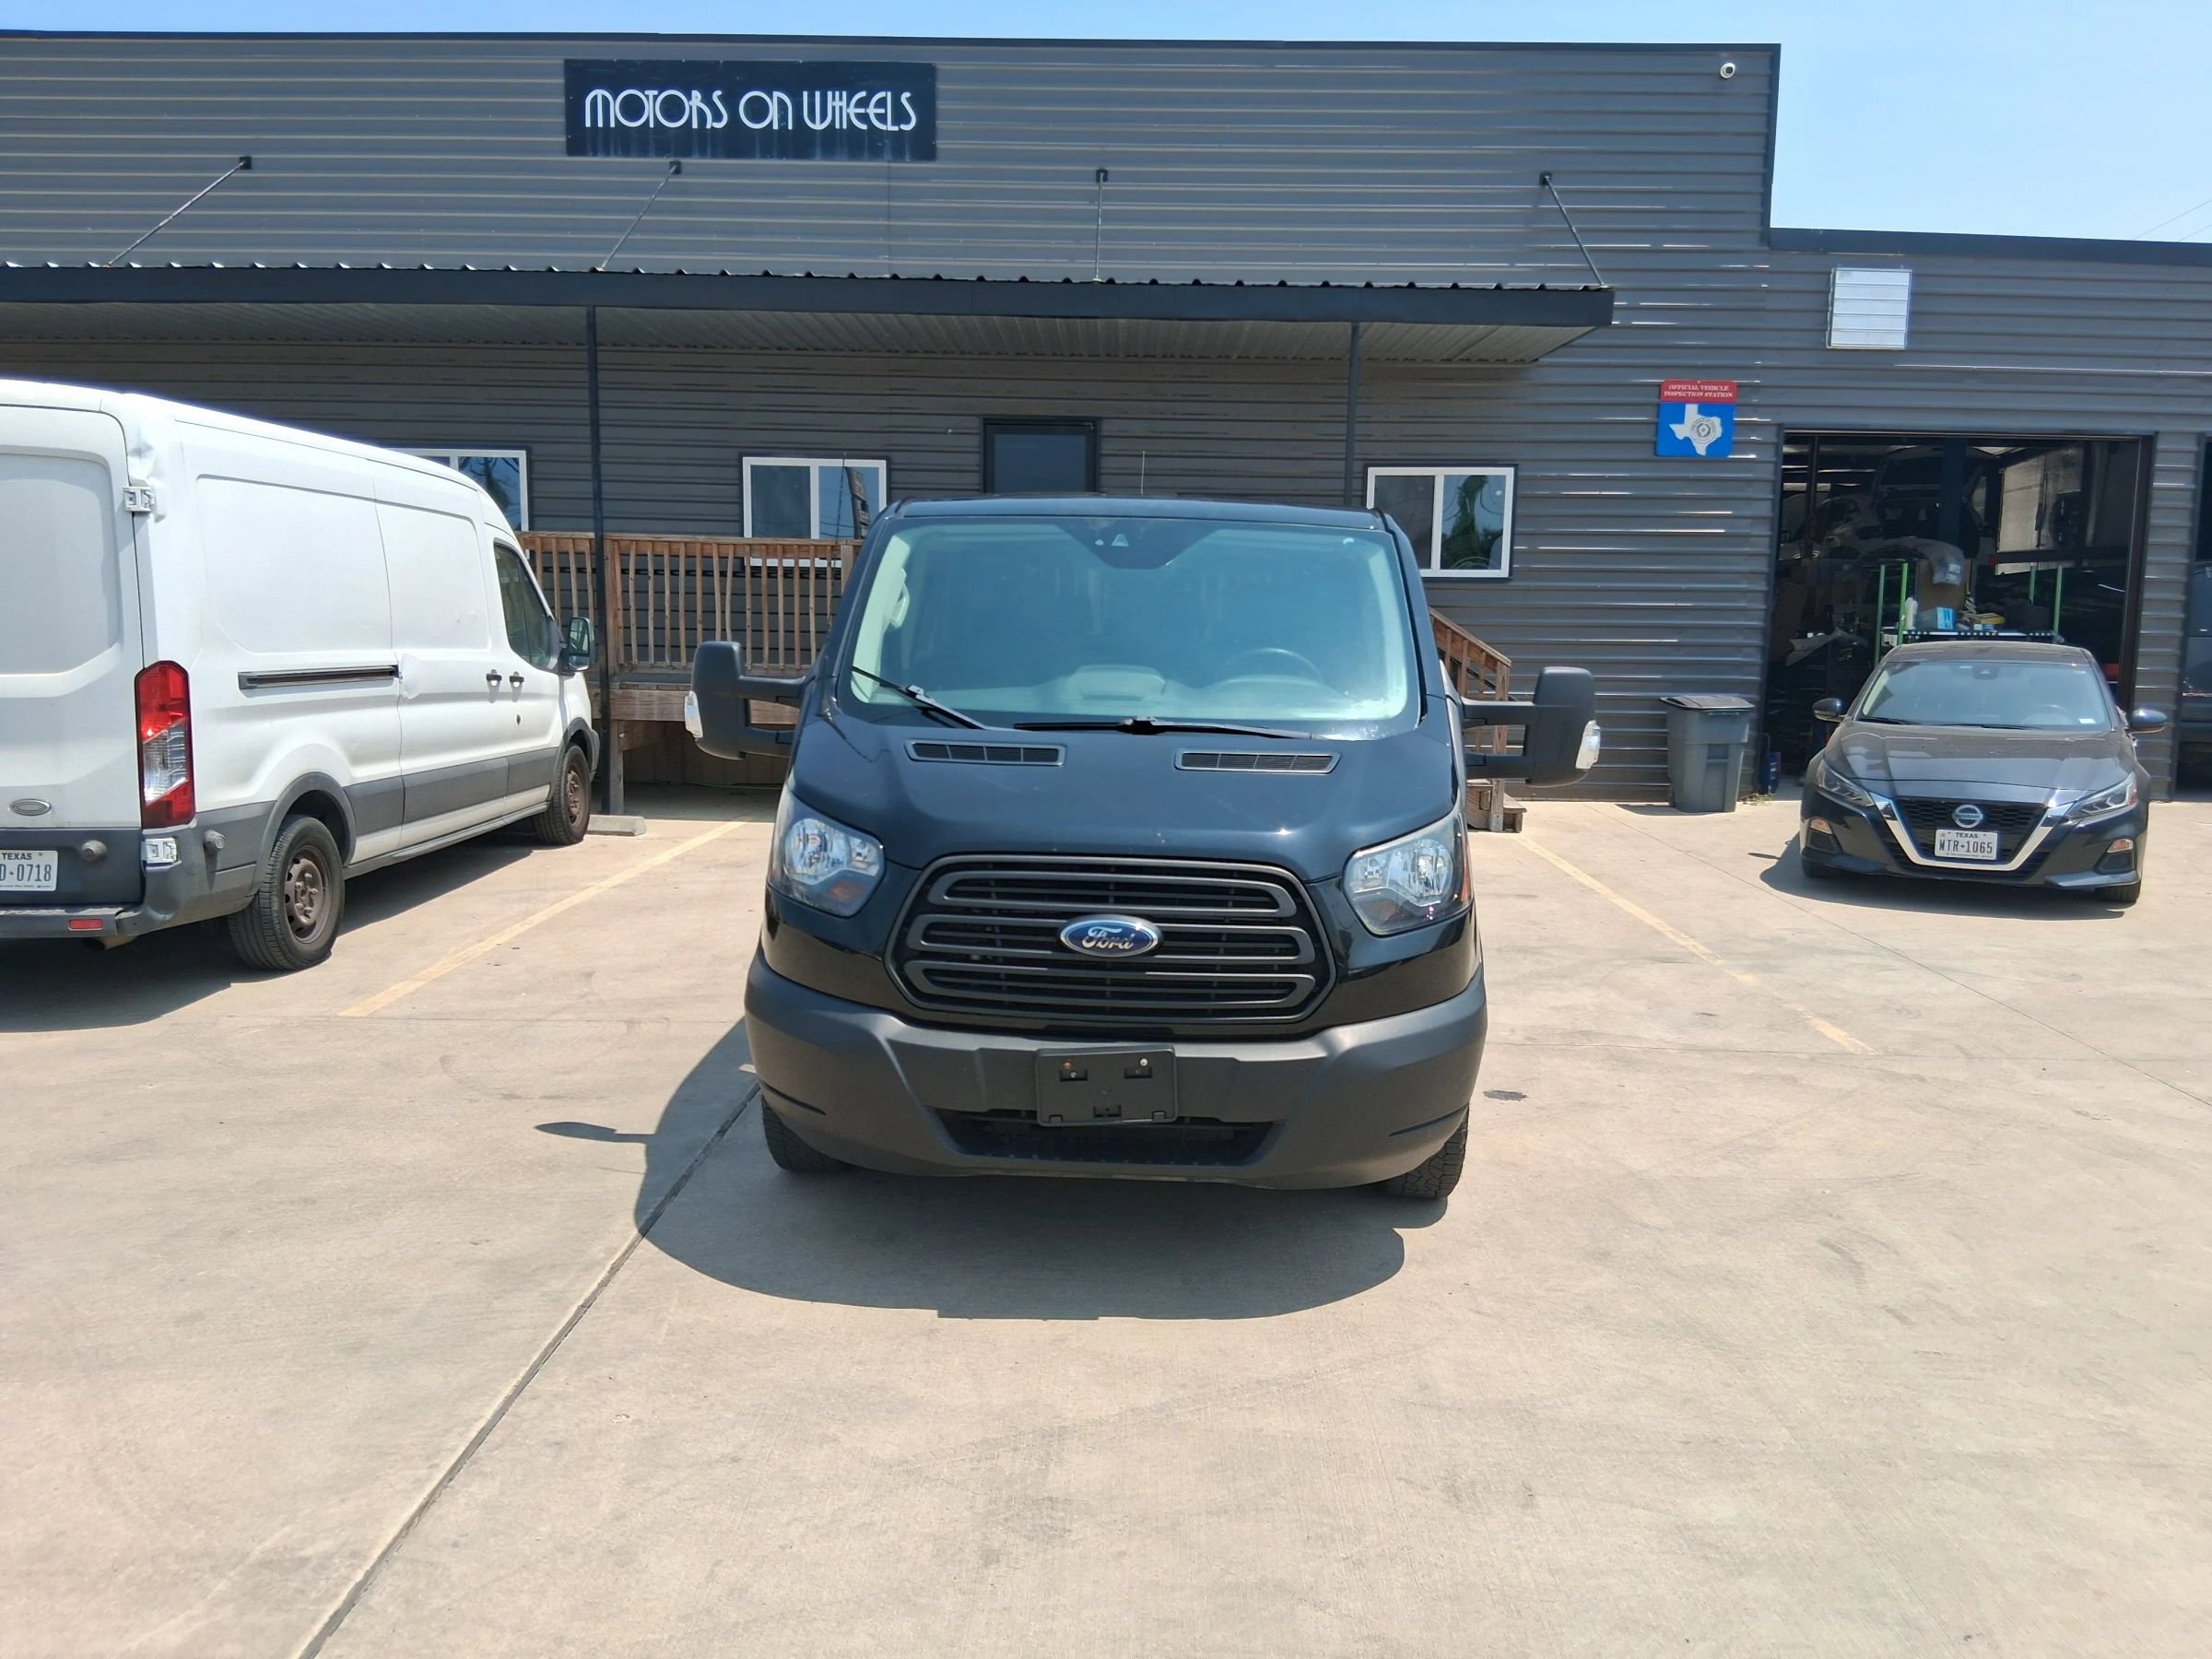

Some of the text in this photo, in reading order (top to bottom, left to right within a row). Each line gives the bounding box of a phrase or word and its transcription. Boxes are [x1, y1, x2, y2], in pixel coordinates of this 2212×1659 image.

[585, 89, 917, 131] MOTORS ON WHEELS
[1082, 925, 1135, 950] Ford
